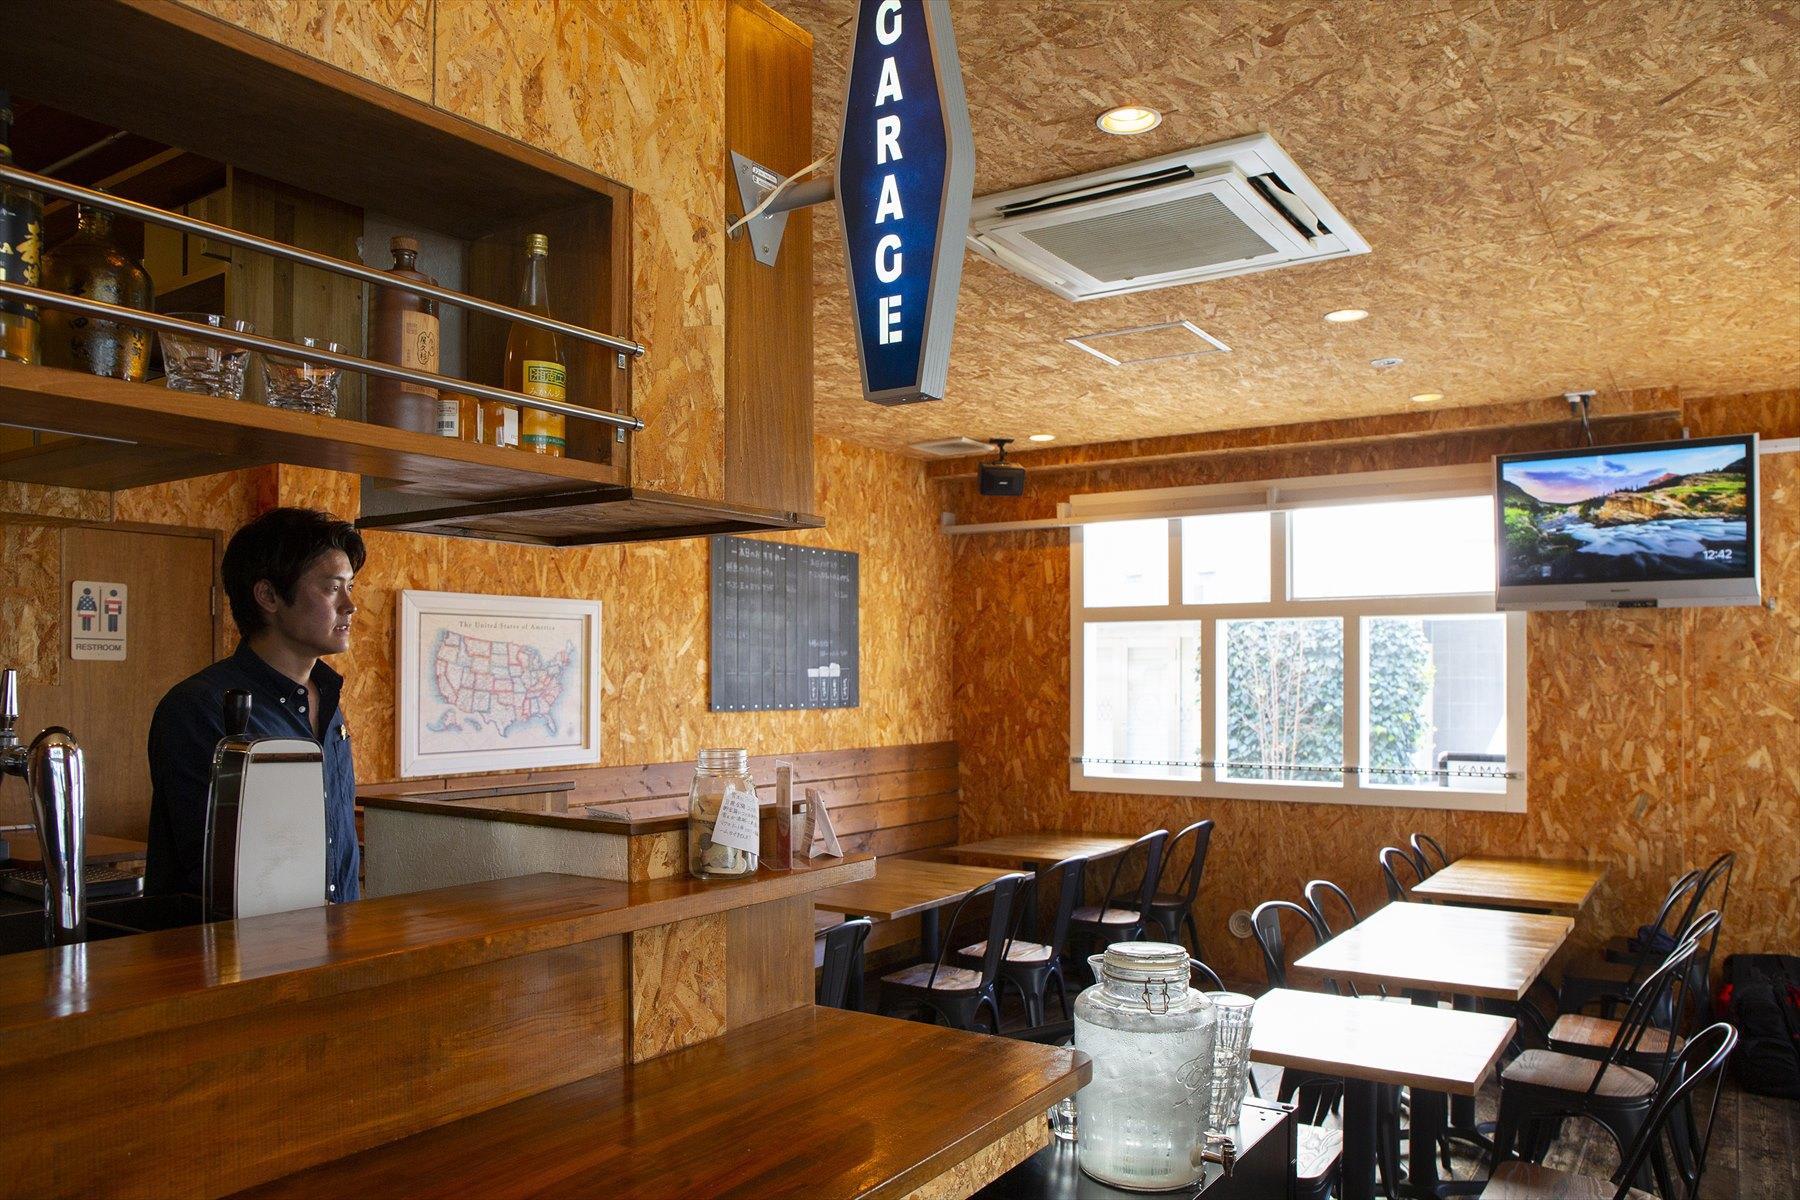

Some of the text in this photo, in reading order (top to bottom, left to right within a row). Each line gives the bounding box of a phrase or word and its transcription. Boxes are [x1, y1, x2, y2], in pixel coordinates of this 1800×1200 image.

[874, 0, 903, 345] GARAGE
[1702, 549, 1732, 560] 12:42
[475, 621, 497, 629] United
[76, 643, 121, 651] RESTROOM
